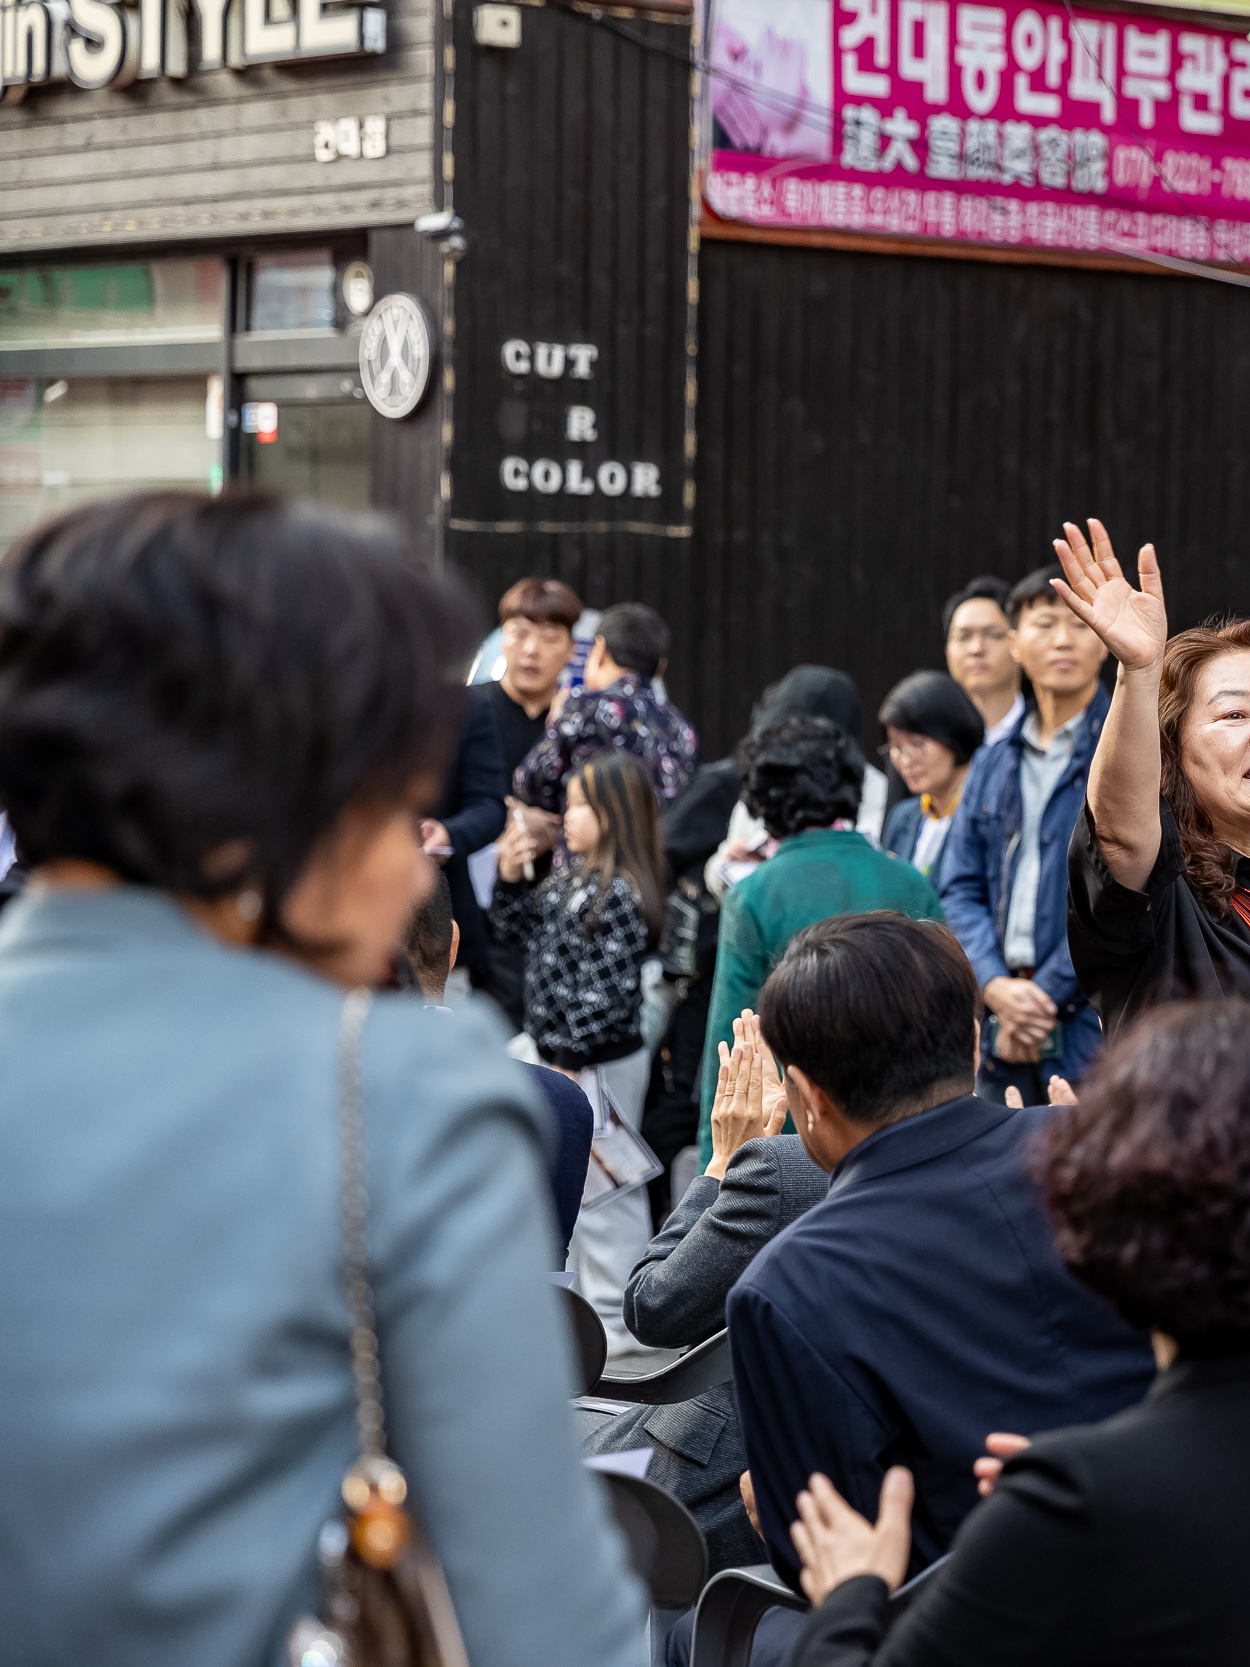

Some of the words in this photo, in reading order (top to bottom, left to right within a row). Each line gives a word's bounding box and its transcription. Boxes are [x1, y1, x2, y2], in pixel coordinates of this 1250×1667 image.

[501, 338, 599, 380] CUT
[565, 405, 598, 443] R
[501, 455, 662, 498] COLOR
